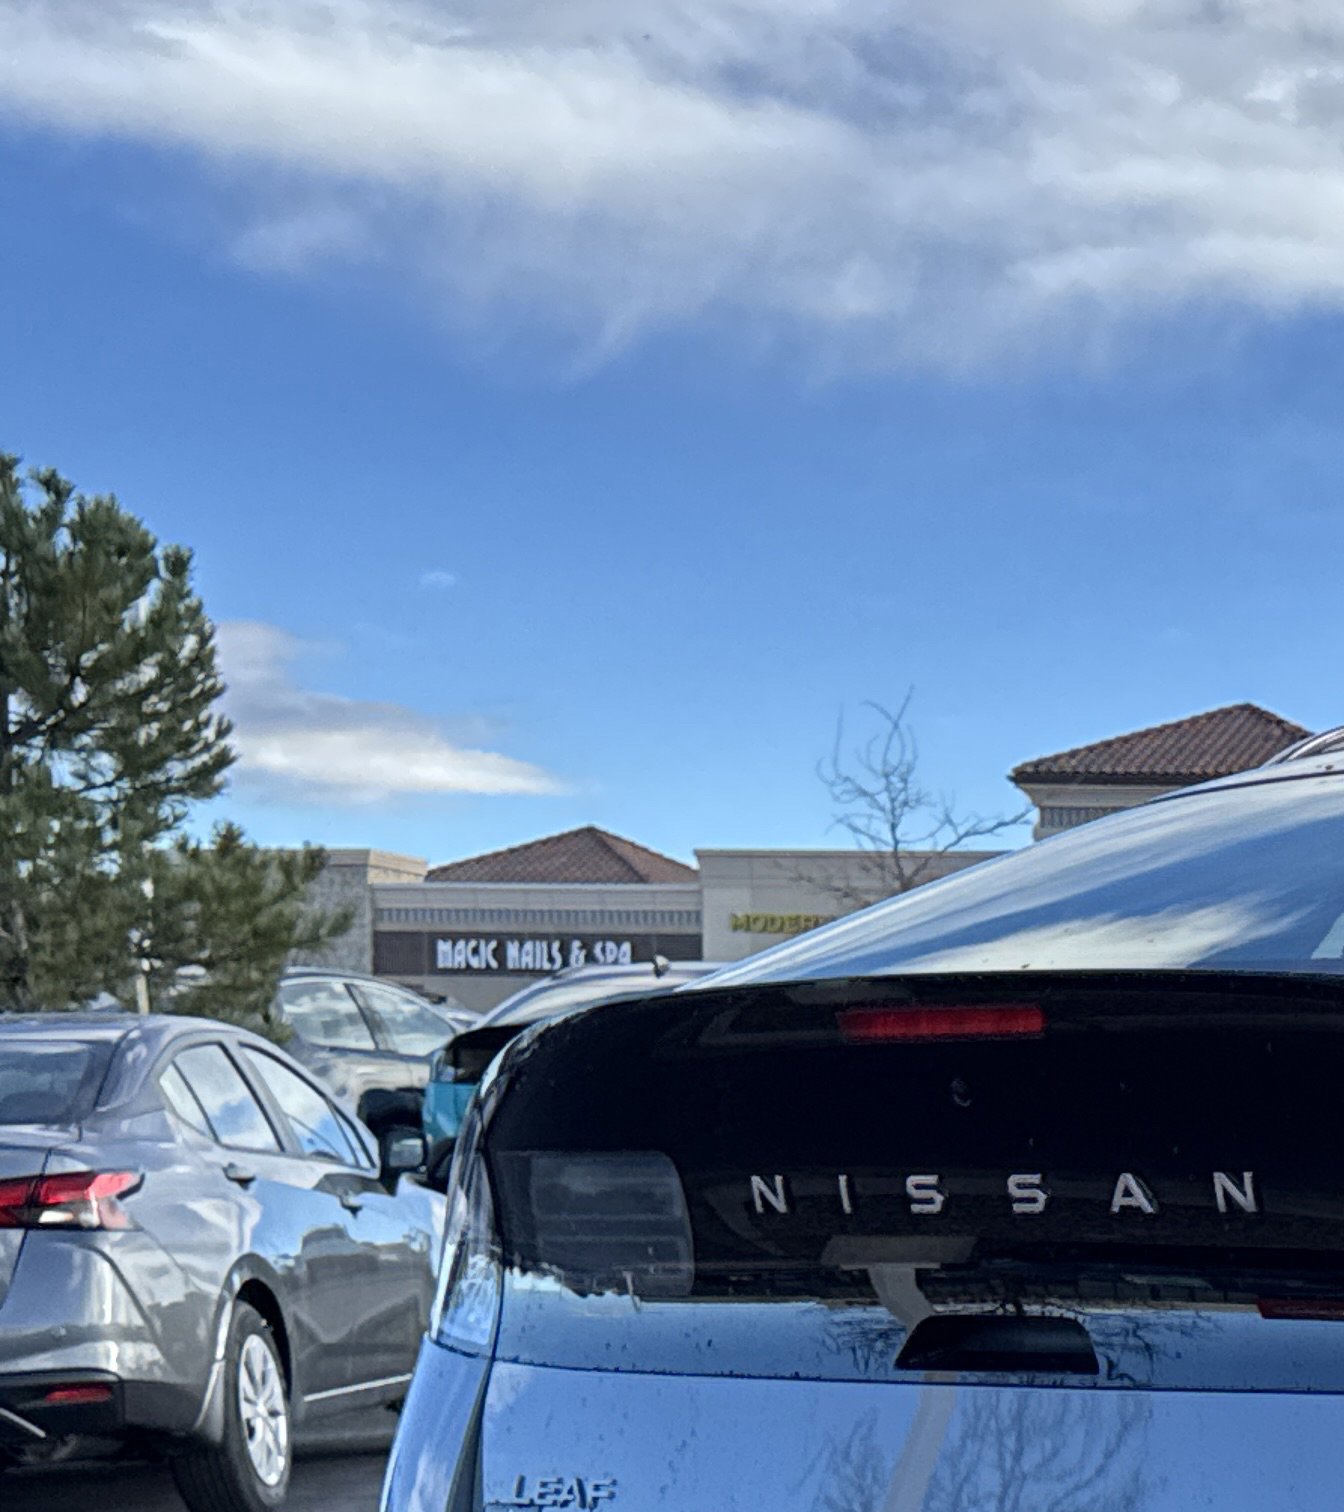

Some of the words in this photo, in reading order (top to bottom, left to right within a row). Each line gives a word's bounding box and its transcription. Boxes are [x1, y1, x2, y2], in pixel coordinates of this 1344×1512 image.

[436, 938, 498, 969] MAGIC
[506, 939, 562, 970] NAILS
[569, 939, 587, 967] &
[593, 941, 632, 964] SPA
[750, 1171, 1258, 1215] NISSAN
[513, 1474, 617, 1512] LEAF
